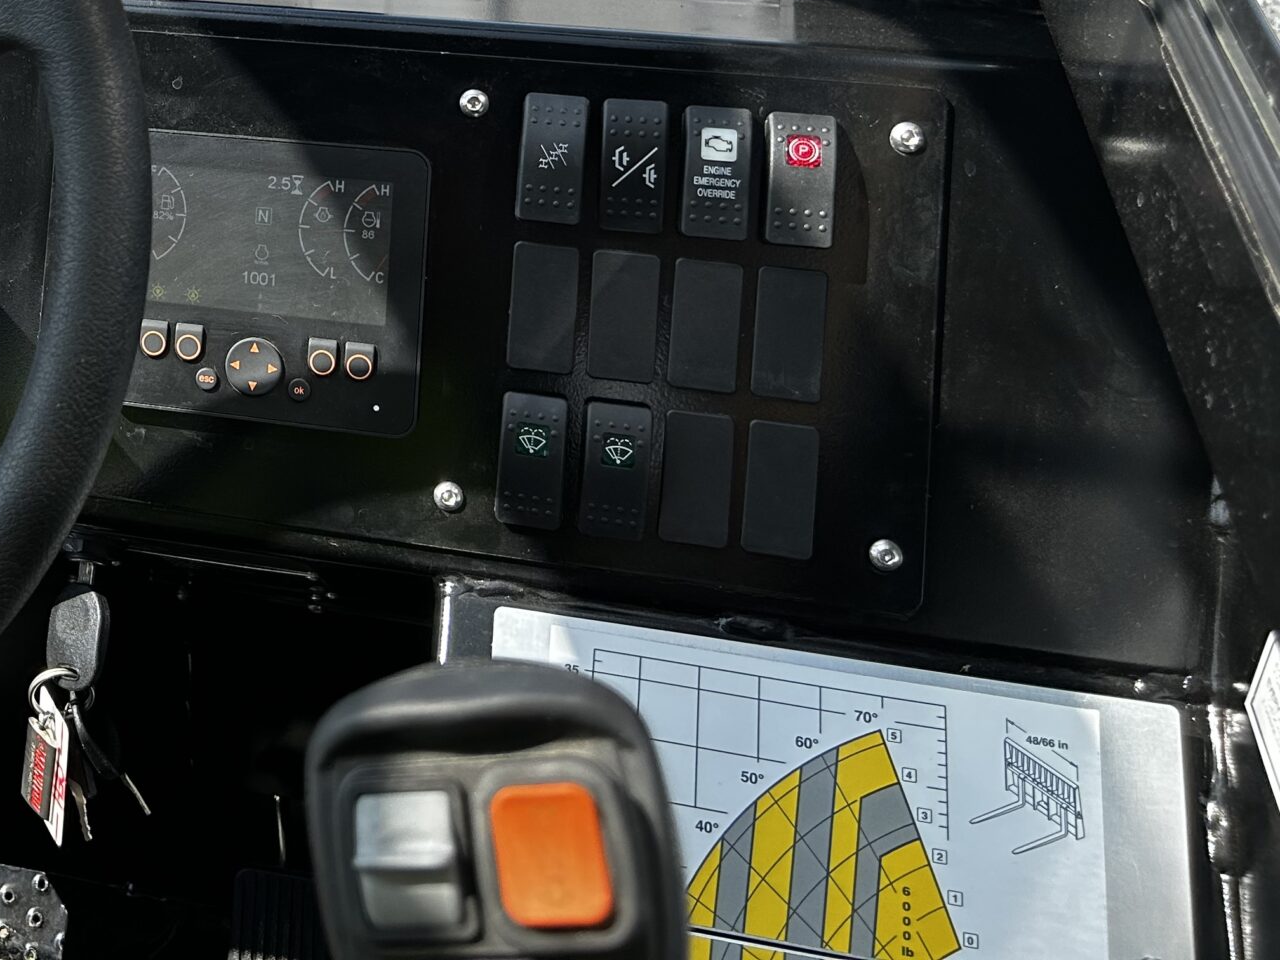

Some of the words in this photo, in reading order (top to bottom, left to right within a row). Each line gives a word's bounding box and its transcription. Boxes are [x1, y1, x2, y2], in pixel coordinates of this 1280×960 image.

[798, 146, 809, 156] P
[703, 165, 732, 176] ENGINE
[268, 176, 291, 190] 2.5
[335, 180, 345, 193] H
[693, 176, 741, 188] EMERGENCY
[381, 184, 390, 196] H
[697, 188, 736, 199] OVERRIDE
[258, 210, 269, 222] N
[242, 271, 275, 286] 1001
[330, 267, 336, 279] L
[375, 272, 384, 284] C
[198, 374, 215, 383] esc
[294, 386, 304, 395] ok
[854, 710, 878, 723] 70°
[890, 731, 897, 740] 5
[795, 736, 818, 749] 60°
[1026, 736, 1055, 748] 48/66
[1058, 740, 1068, 750] in
[740, 772, 764, 785] 50°
[905, 771, 913, 780] 4
[921, 811, 928, 820] 3
[695, 821, 719, 834] 40°
[936, 852, 943, 861] 2
[952, 894, 958, 903] 1
[967, 936, 974, 946] 0
[901, 947, 915, 958] lb
